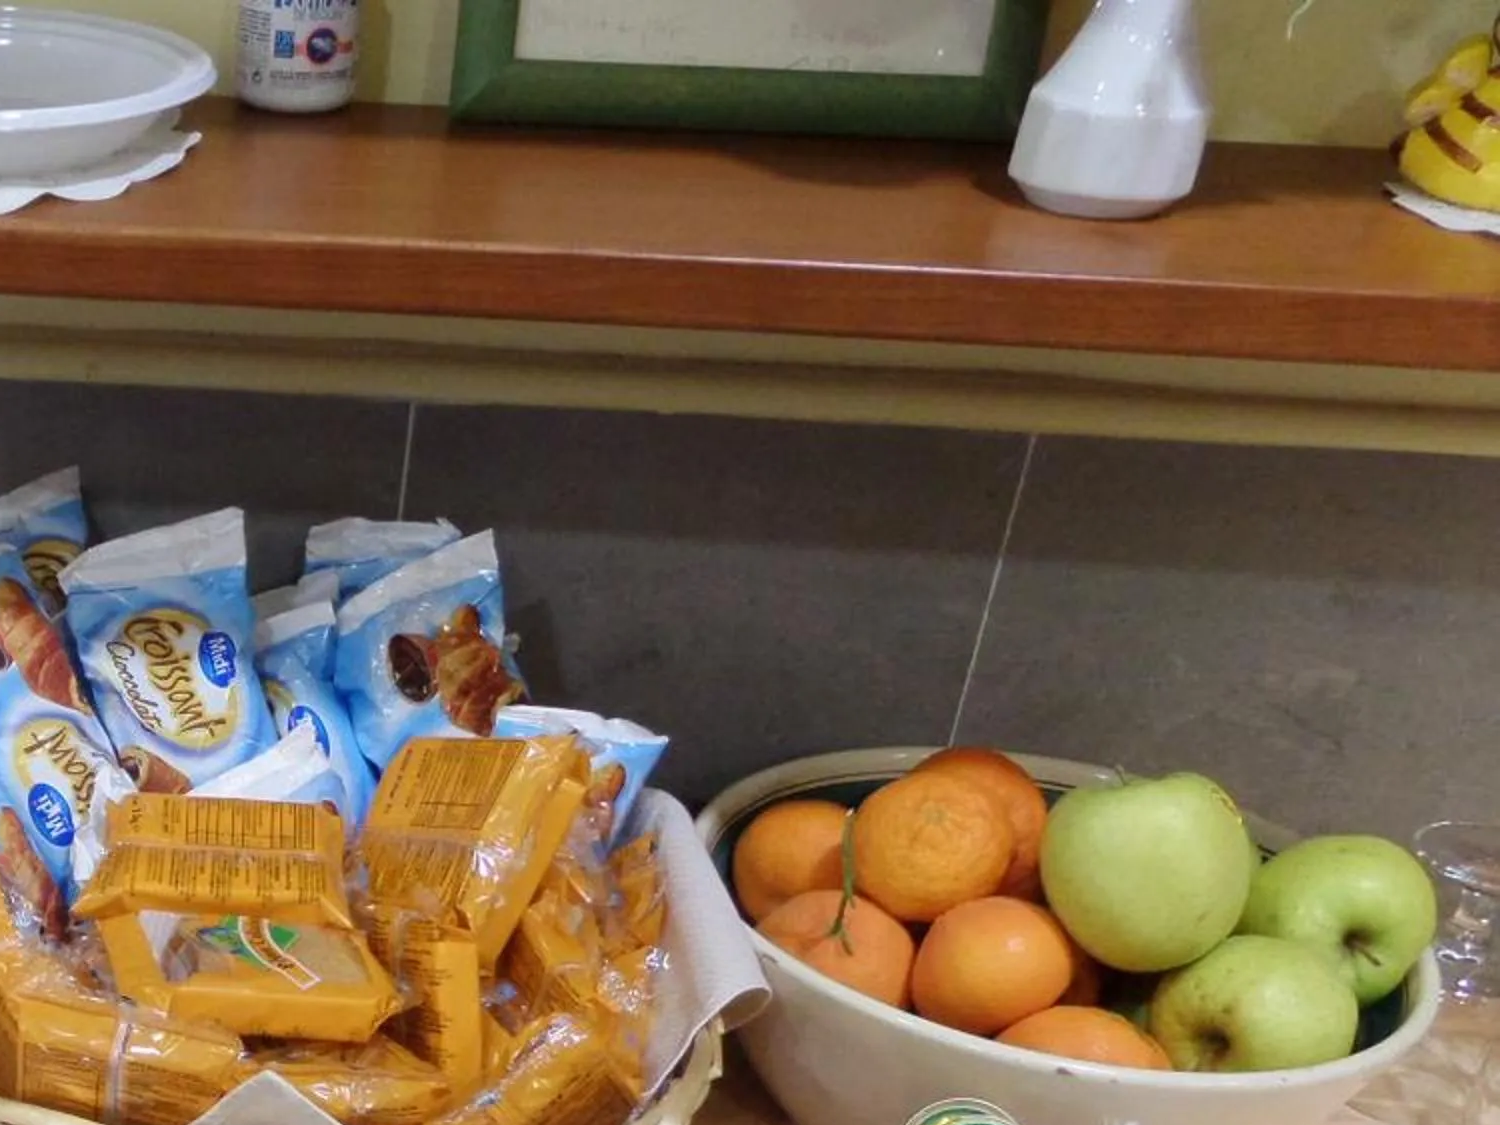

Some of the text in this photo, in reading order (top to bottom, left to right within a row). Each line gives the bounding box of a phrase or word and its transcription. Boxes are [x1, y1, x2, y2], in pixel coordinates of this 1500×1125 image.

[123, 616, 227, 738] Croissant
[206, 637, 228, 676] Midi
[35, 793, 68, 839] Midi
